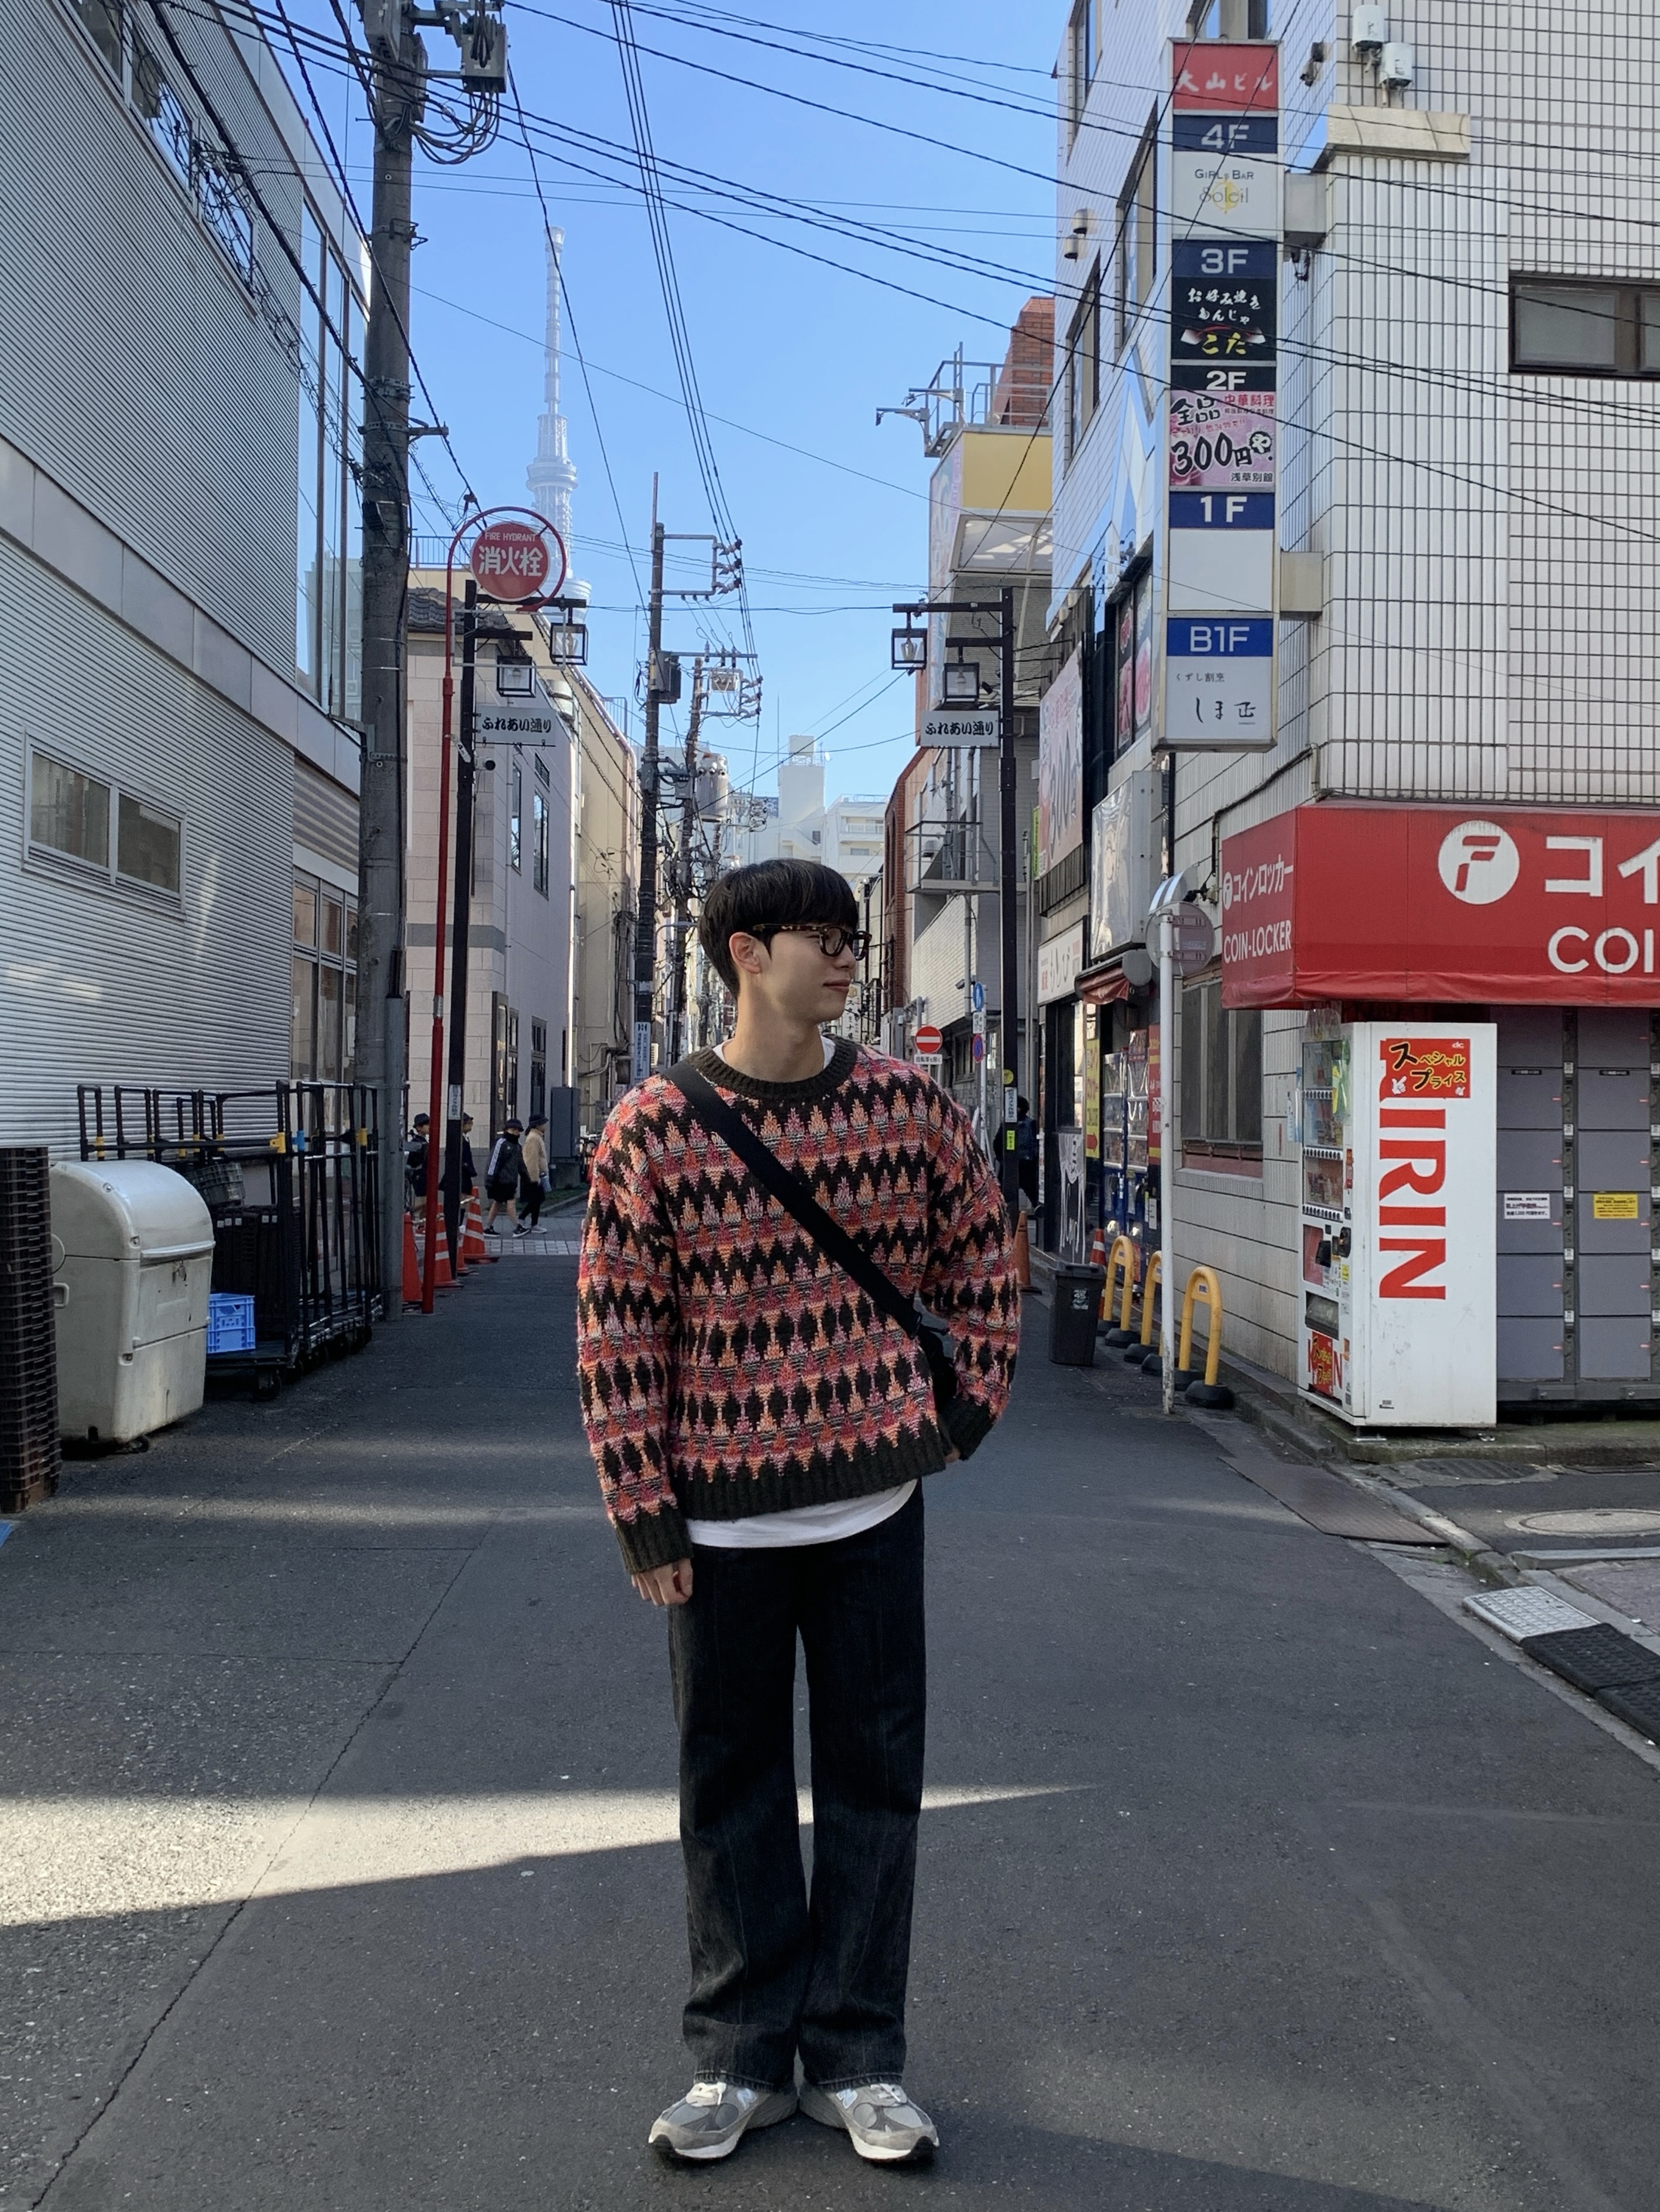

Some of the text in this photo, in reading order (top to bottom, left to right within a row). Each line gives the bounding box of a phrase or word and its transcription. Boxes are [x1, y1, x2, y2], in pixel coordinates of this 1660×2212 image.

[1174, 70, 1273, 92] 大山ビル
[1201, 124, 1250, 149] 4F
[1201, 248, 1249, 274] 3F
[1188, 288, 1261, 310] お好み焼き
[1198, 307, 1250, 325] もんじゃ
[1202, 332, 1247, 355] こた
[1206, 370, 1247, 391] 2F
[1171, 397, 1220, 426] 全品
[1225, 394, 1275, 407] 中華料理
[1230, 472, 1273, 482] 浅草別館
[1201, 496, 1248, 523] 1F
[485, 532, 536, 542] FIRE HYDRANT
[478, 545, 543, 576] 消火栓
[1189, 626, 1250, 652] B1F
[1177, 673, 1225, 682] くずし割烹
[482, 717, 551, 733] ふれあい通り
[925, 720, 994, 736] ふれあい通り
[1233, 853, 1294, 904] コインロッカー
[1545, 835, 1660, 904] コイ
[1223, 919, 1292, 964] COIN-LOCKER
[1548, 926, 1654, 974] COI
[1389, 1041, 1467, 1071] スペシャル
[1410, 1067, 1467, 1092] プライス
[1378, 1040, 1446, 1297] IRIN
